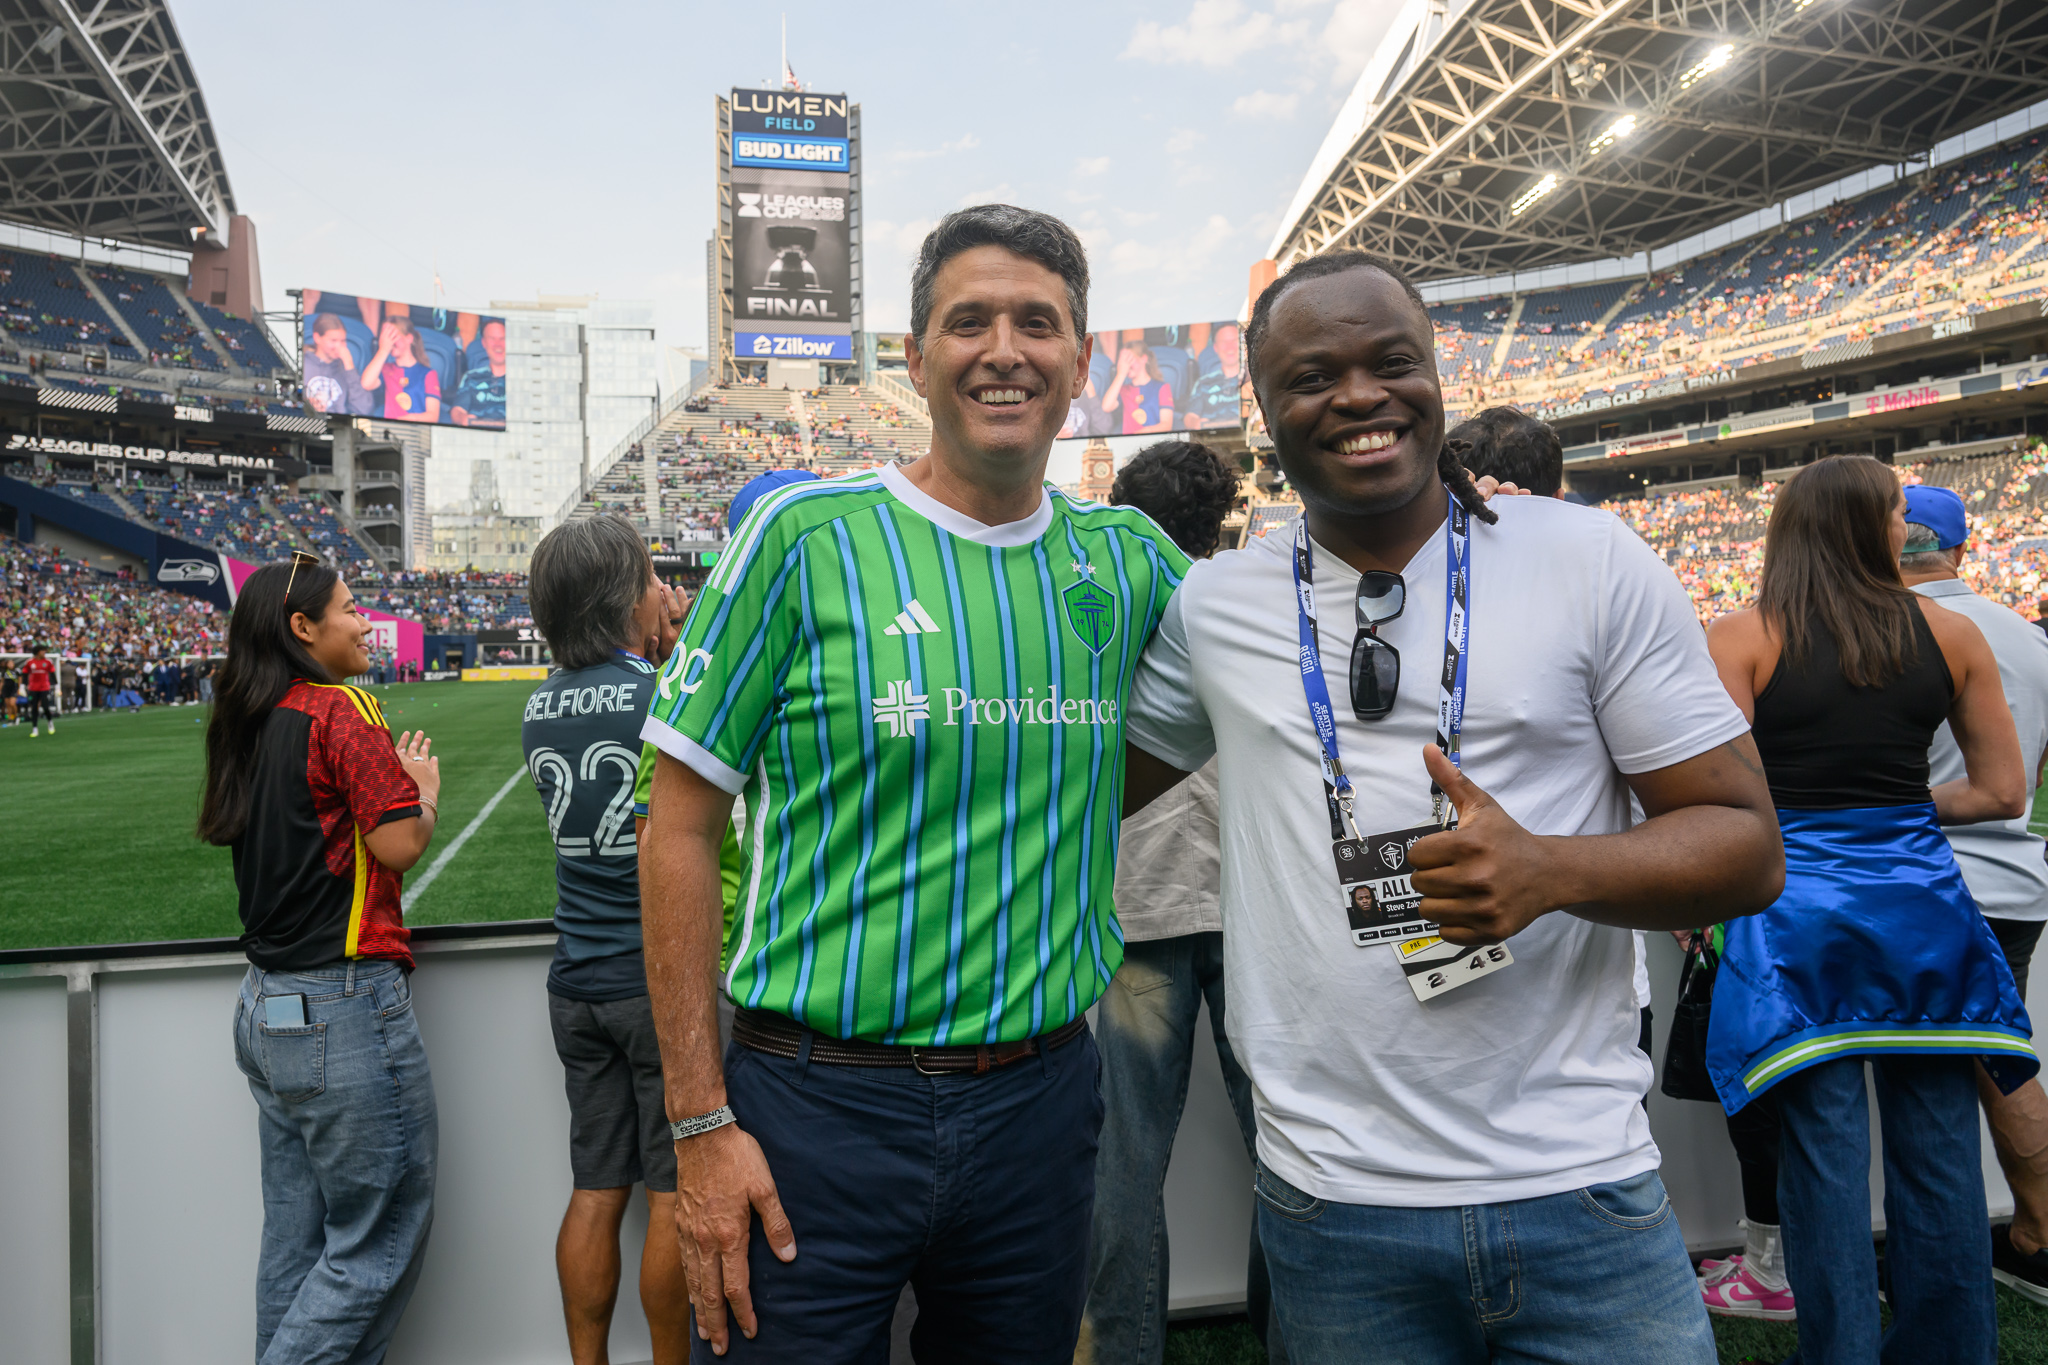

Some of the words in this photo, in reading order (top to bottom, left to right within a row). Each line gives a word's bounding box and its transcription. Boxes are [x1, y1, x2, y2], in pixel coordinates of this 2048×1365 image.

[733, 92, 847, 118] LUMEN
[765, 116, 816, 132] FIELD
[738, 140, 783, 159] BUD
[784, 143, 843, 162] LIGHT
[762, 193, 845, 211] LEAGUES
[762, 205, 801, 220] CUP
[747, 296, 838, 318] FINAL
[1945, 316, 1973, 337] FINAL
[773, 336, 833, 357] Zillow
[1612, 389, 1645, 406] CUP
[1688, 369, 1738, 390] FINAL
[1883, 386, 1940, 412] Mobile
[186, 408, 211, 422] FINAL
[124, 446, 166, 463] CUP
[219, 455, 281, 471] FINAL
[1102, 620, 1110, 628] 74
[524, 684, 638, 722] BELFIORE
[942, 685, 1118, 726] Providence
[1453, 686, 1462, 730] SOUNDERS
[1312, 702, 1329, 743] SOUNDERS
[1320, 704, 1334, 738] SEATTLE
[529, 740, 641, 856] 22
[1382, 879, 1411, 899] ALL
[1386, 903, 1405, 912] Steve
[1410, 940, 1421, 950] PRE
[674, 1118, 692, 1128] CLUB
[694, 1107, 724, 1120] TUNNEL
[680, 1116, 722, 1135] SOUNDERS
